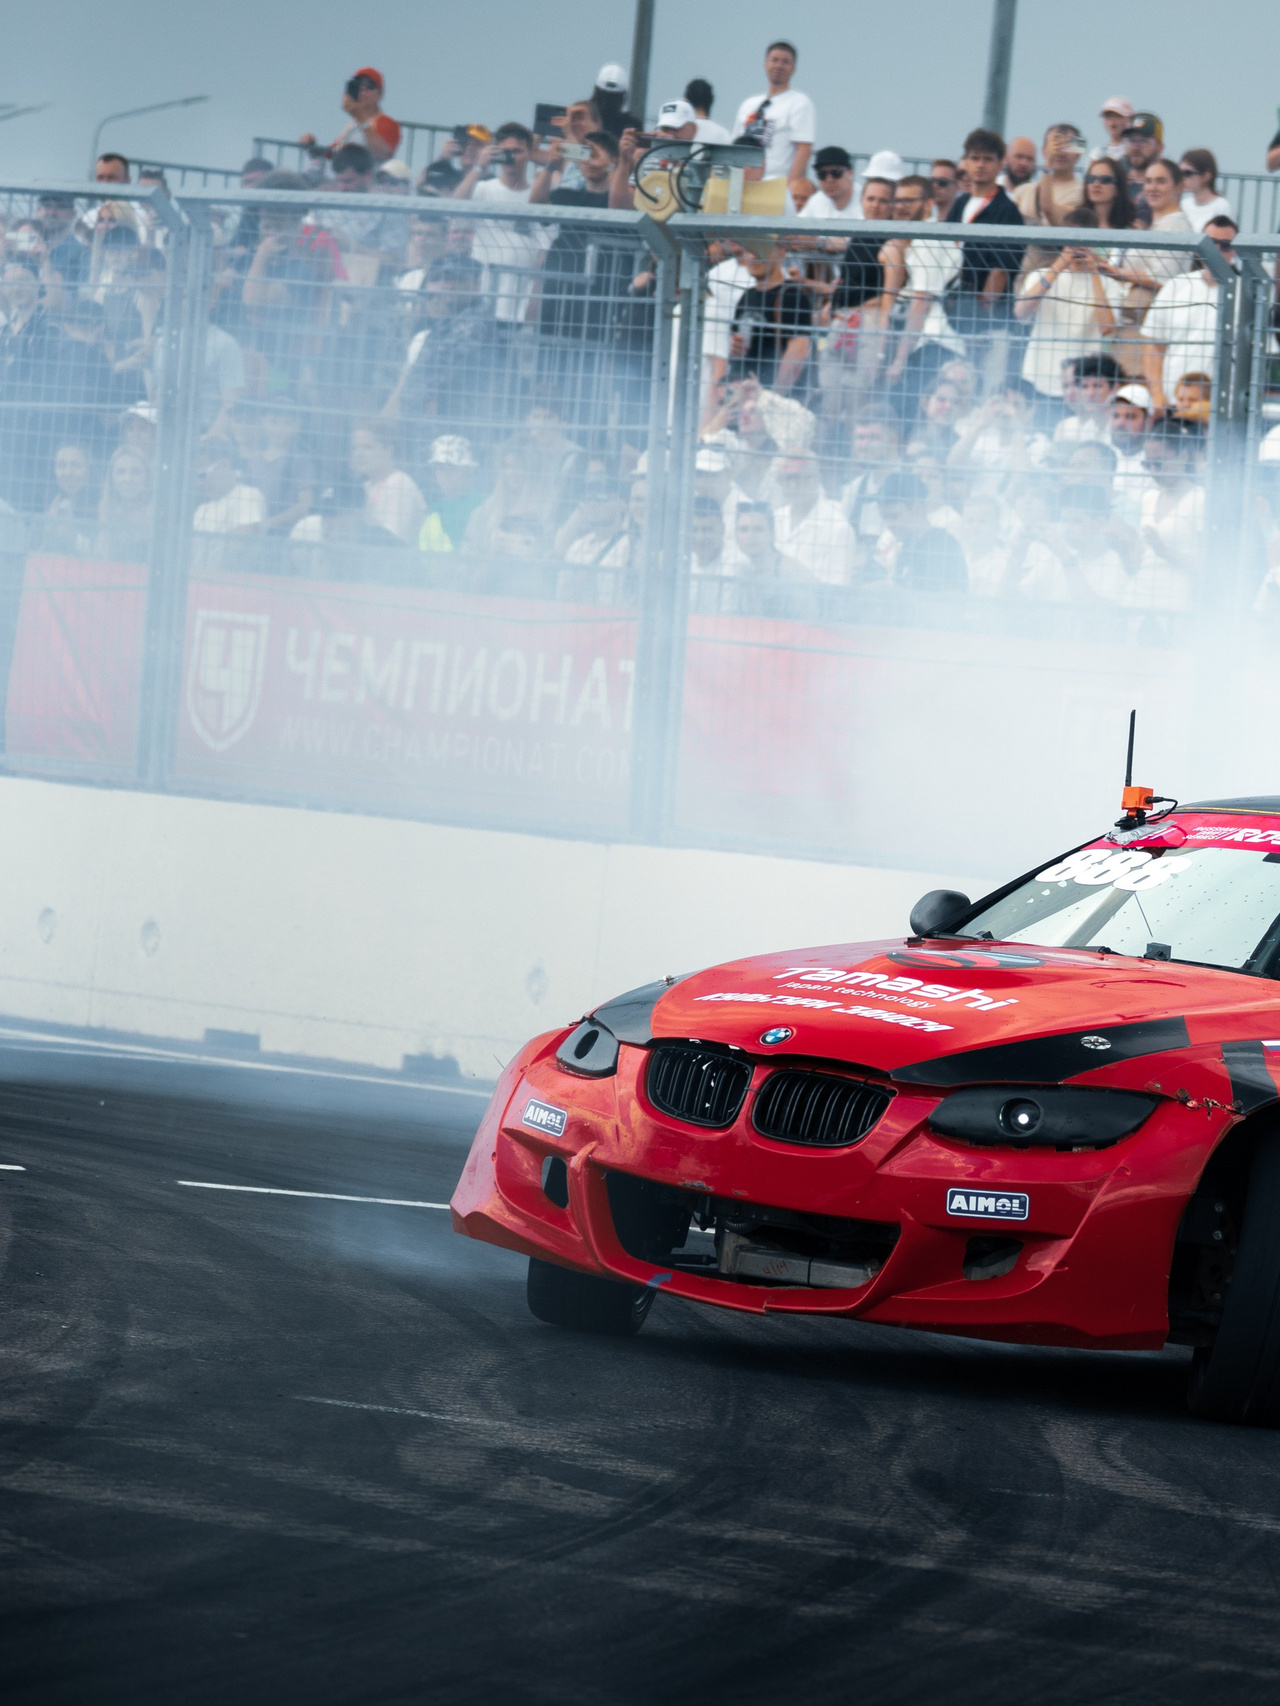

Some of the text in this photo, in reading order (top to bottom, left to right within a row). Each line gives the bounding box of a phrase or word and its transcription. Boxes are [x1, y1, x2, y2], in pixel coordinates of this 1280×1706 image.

[1034, 848, 1193, 892] 888
[772, 966, 1020, 1012] Tamashi
[834, 984, 937, 1010] technology
[831, 1005, 955, 1034] ЗАНОСА
[524, 1104, 563, 1131] AIMOL
[950, 1194, 1025, 1215] AIMOL
